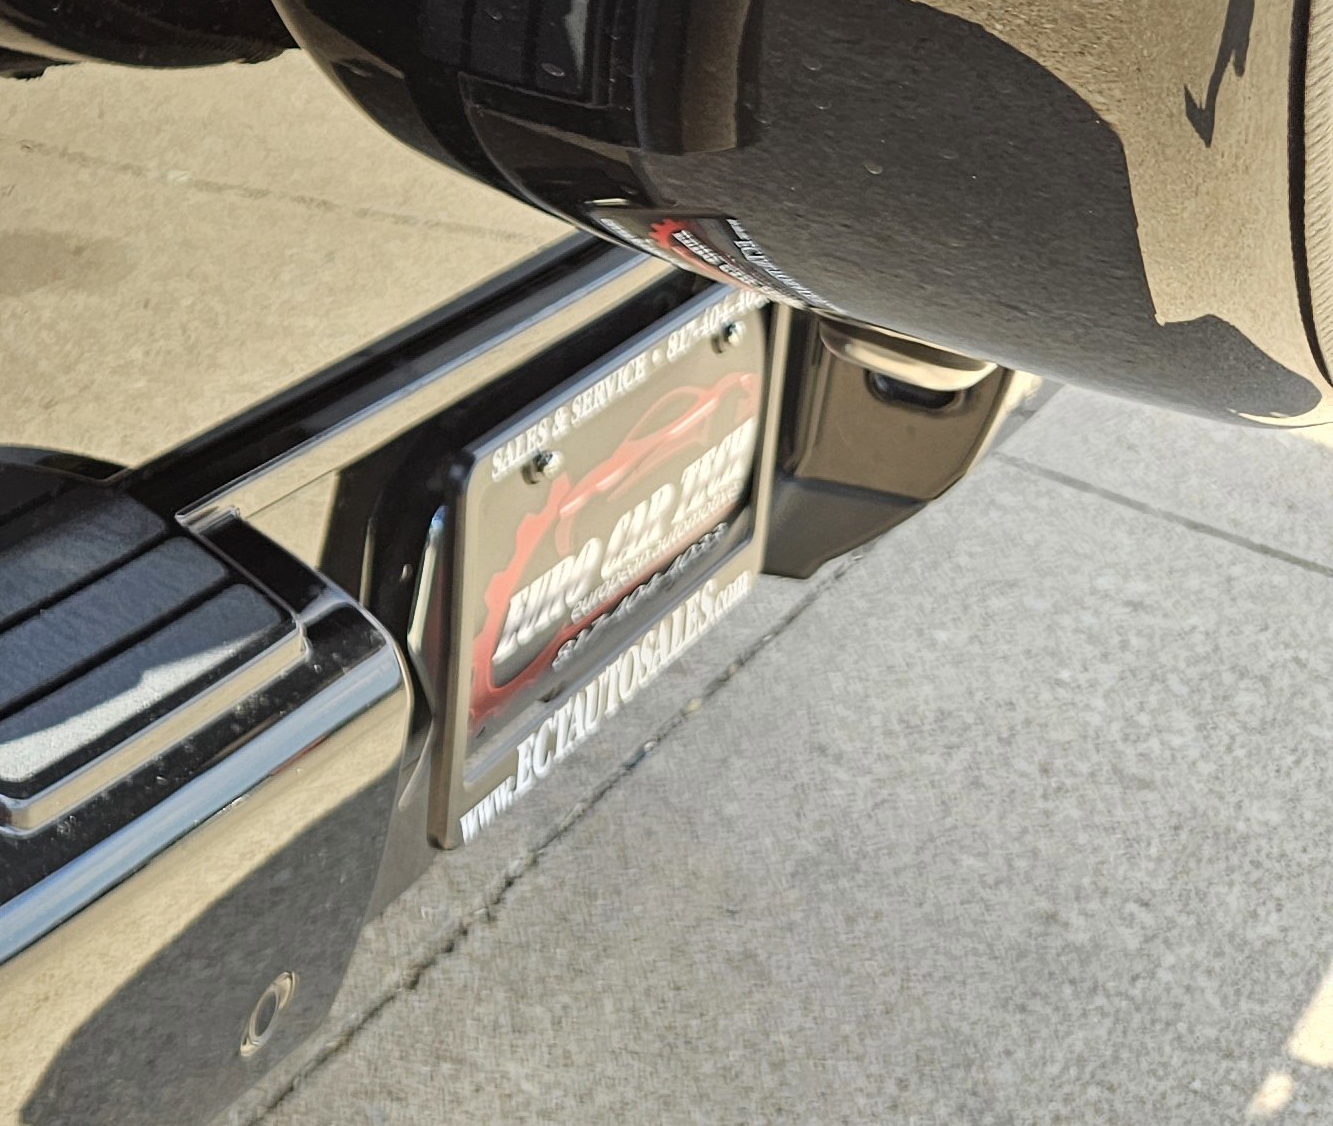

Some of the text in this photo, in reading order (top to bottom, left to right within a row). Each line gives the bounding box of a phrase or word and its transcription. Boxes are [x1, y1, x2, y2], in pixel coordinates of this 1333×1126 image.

[491, 423, 553, 482] SALES
[550, 405, 572, 442] &
[570, 351, 649, 425] SERVICE
[492, 537, 603, 665] EURO
[601, 482, 675, 580] CAR
[459, 569, 754, 845] www.ECTAUTOSALES.com
